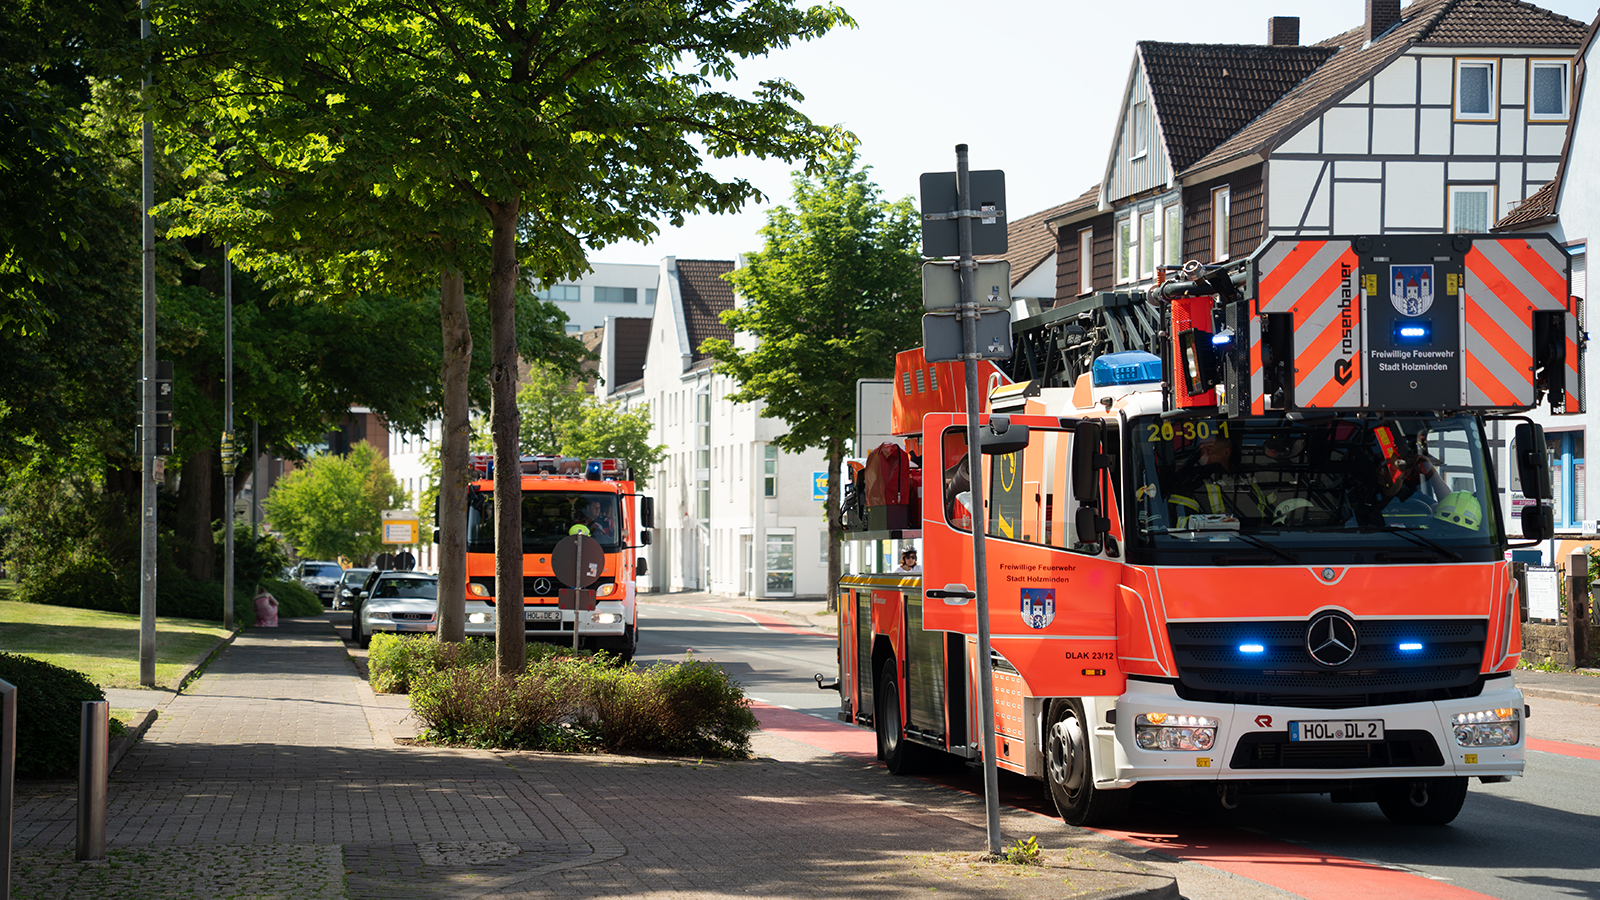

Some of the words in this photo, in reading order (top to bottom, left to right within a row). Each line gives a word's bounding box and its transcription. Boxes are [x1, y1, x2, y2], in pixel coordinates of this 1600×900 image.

[1337, 262, 1352, 355] rosenbauer
[1371, 350, 1412, 360] Freiwillige
[1413, 350, 1455, 358] Feuerwehr
[1379, 362, 1400, 371] Stadt
[1401, 362, 1448, 371] Holzminden
[1147, 421, 1230, 442] 20-30-1
[1000, 563, 1036, 572] Freiwillige
[1037, 563, 1076, 572] Feuerwehr
[1006, 574, 1026, 583] Stadt
[1026, 574, 1070, 583] Holzminden
[526, 611, 540, 619] HOL
[543, 611, 553, 619] DE
[554, 611, 560, 619] 2
[1065, 651, 1090, 660] DLAK
[1092, 651, 1114, 660] 23/12
[1304, 723, 1334, 739] HOL
[1344, 722, 1365, 739] DL
[1367, 722, 1377, 738] 2
